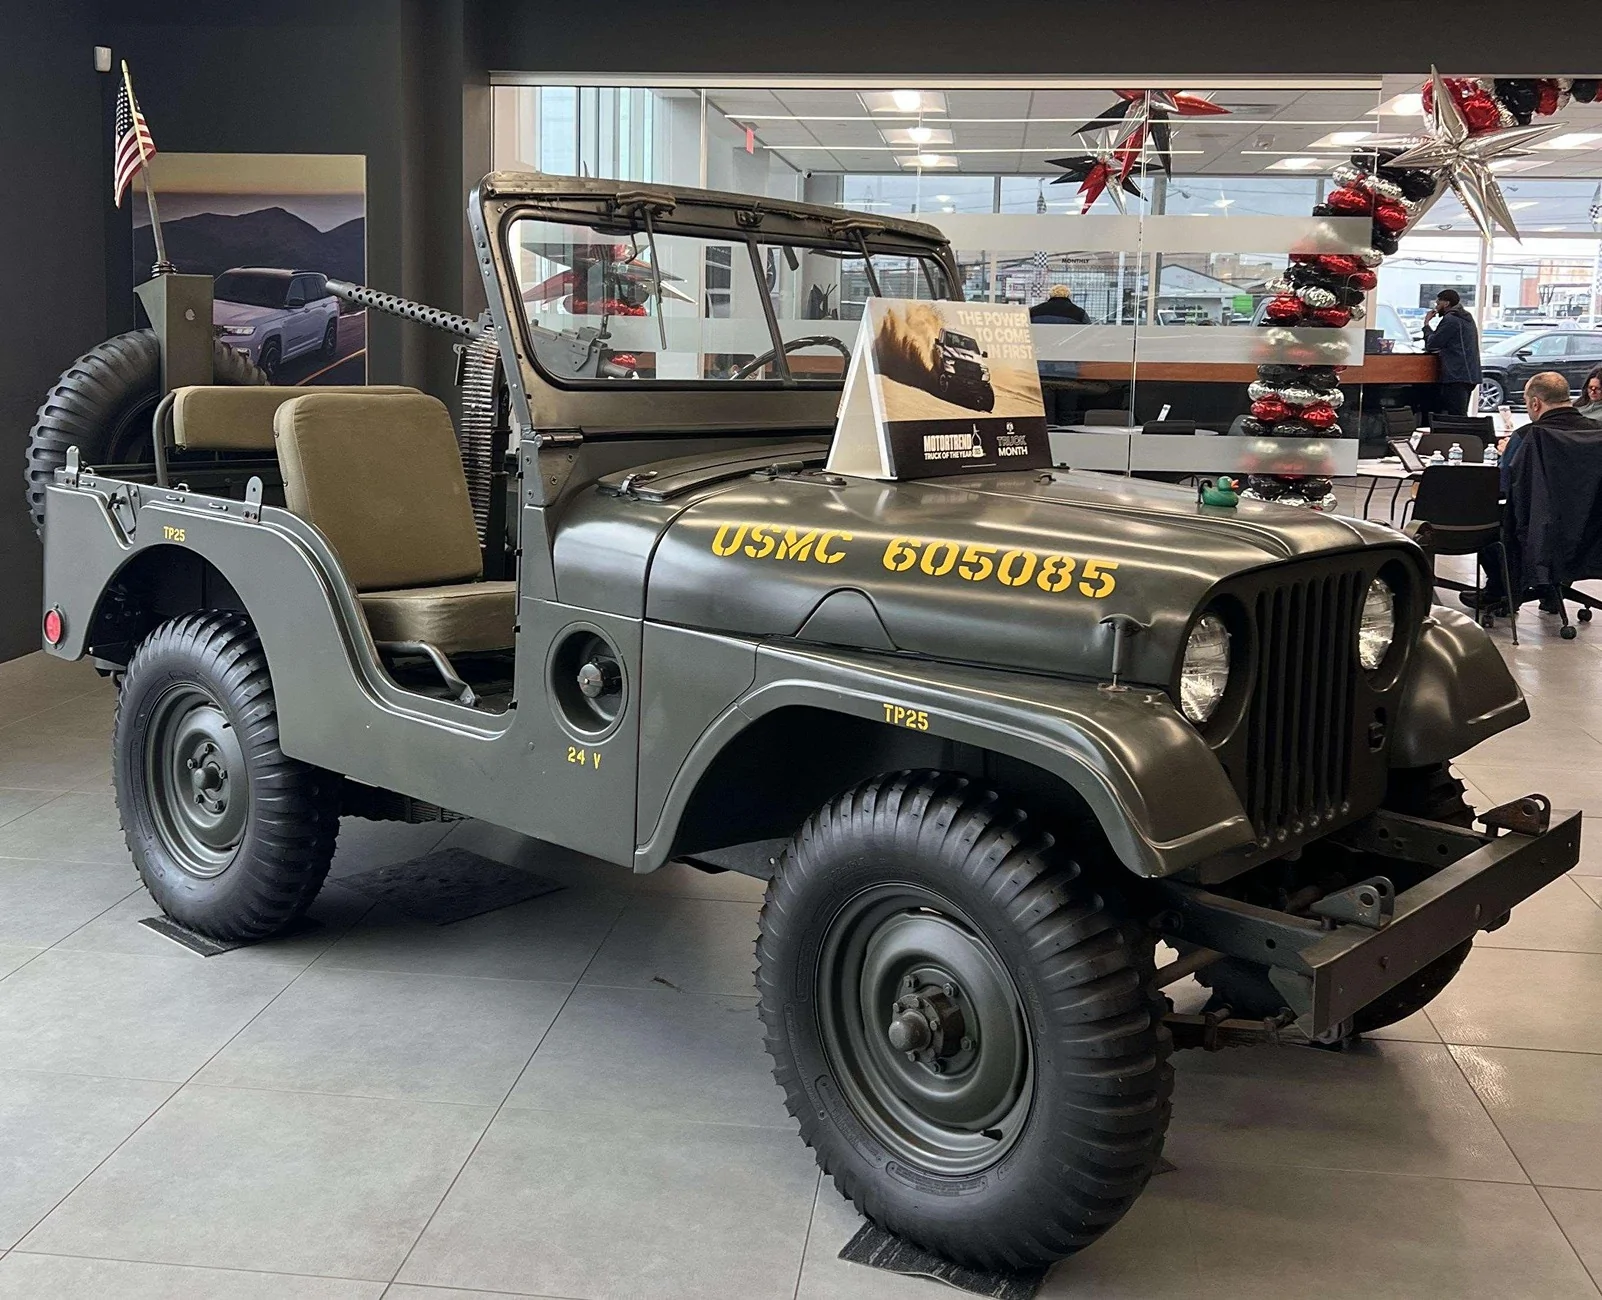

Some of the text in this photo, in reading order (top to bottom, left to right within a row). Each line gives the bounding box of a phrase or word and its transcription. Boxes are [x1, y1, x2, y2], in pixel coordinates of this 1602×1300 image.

[957, 310, 1030, 327] THE POWER
[975, 328, 1031, 343] TO COME
[986, 344, 1033, 359] IN FIRST
[923, 433, 972, 452] MOTORTREND
[995, 435, 1027, 447] TRUCK
[924, 451, 942, 460] TRUCK
[941, 451, 950, 459] OF
[949, 451, 960, 459] THE
[959, 450, 972, 458] YEAR
[998, 446, 1028, 457] MONTH
[163, 525, 186, 542] TP25
[711, 521, 1119, 598] USMC 605085
[883, 703, 929, 731] TP25
[567, 746, 601, 770] 24 V
